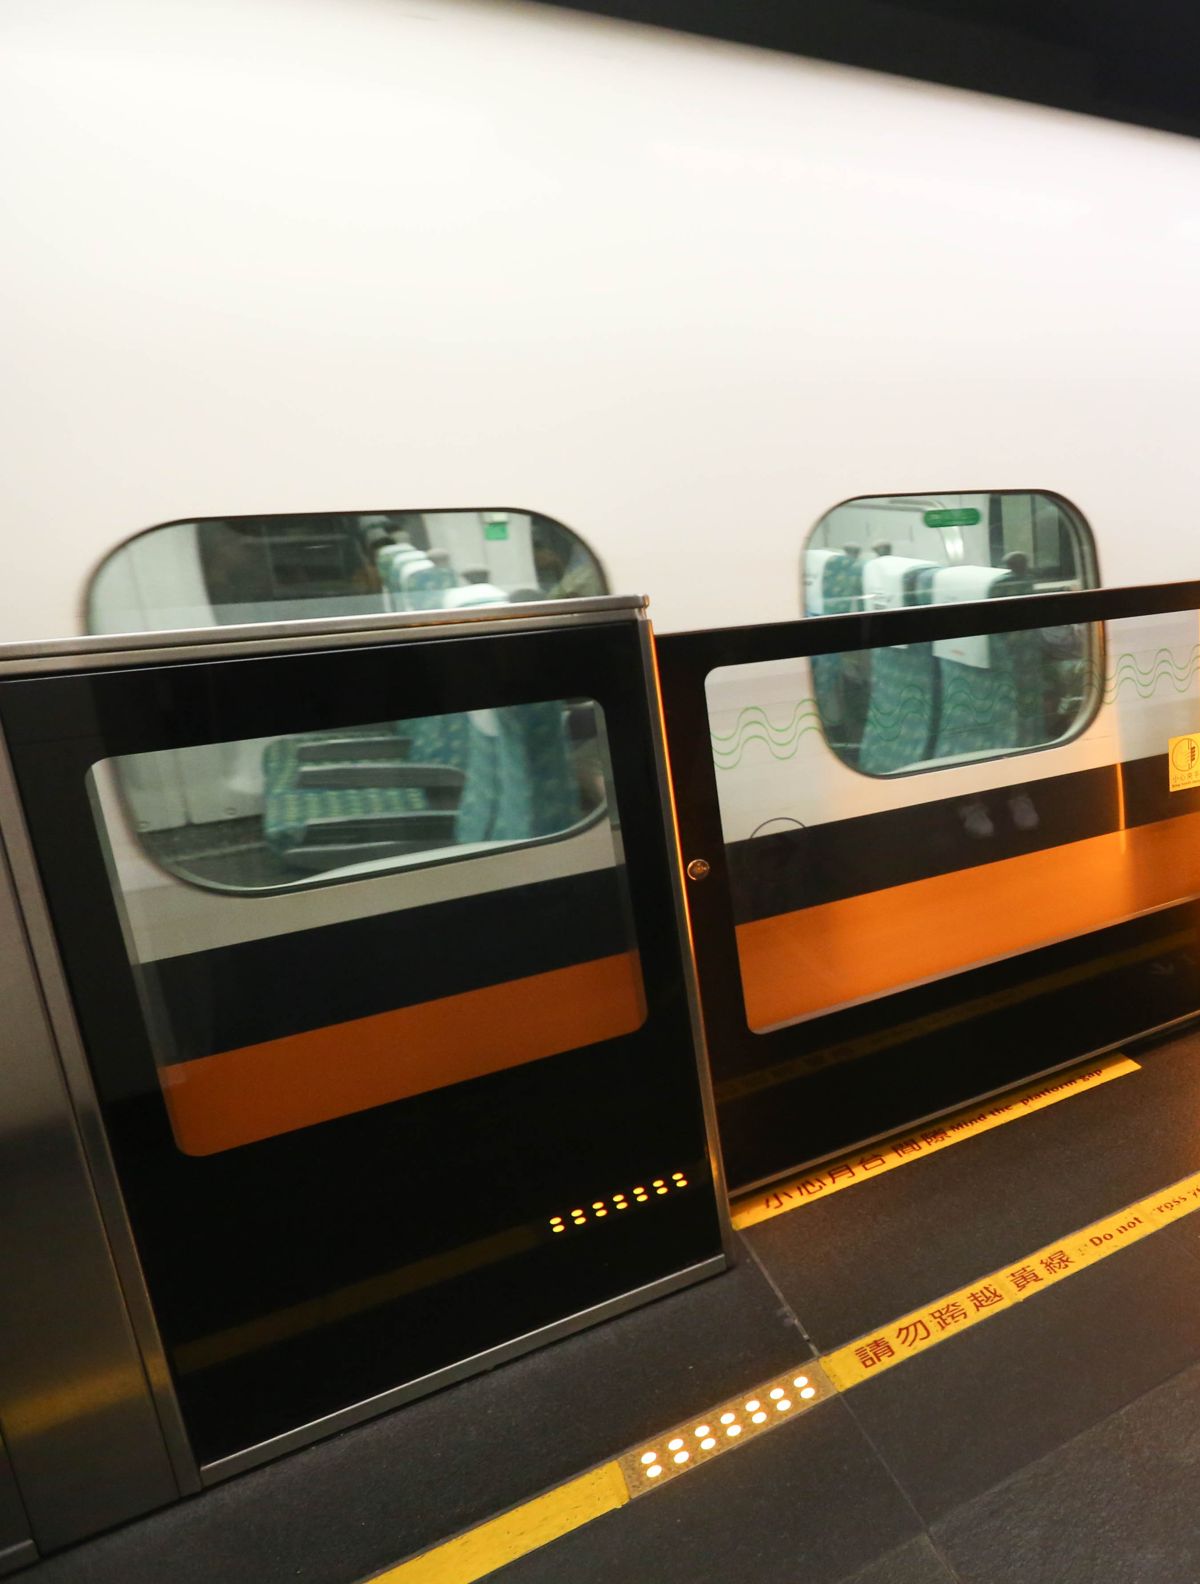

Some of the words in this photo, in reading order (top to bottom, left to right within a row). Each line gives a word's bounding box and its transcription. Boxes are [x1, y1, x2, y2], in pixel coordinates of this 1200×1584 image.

[765, 1128, 951, 1209] 小心月台間隙
[951, 1113, 987, 1132] Mind
[990, 1103, 1015, 1117] the
[1079, 1068, 1102, 1083] gap
[854, 1250, 1075, 1368] 請勿跨越黃線
[1089, 1232, 1113, 1247] Do
[1116, 1216, 1144, 1234] not
[1153, 1196, 1187, 1213] ross
